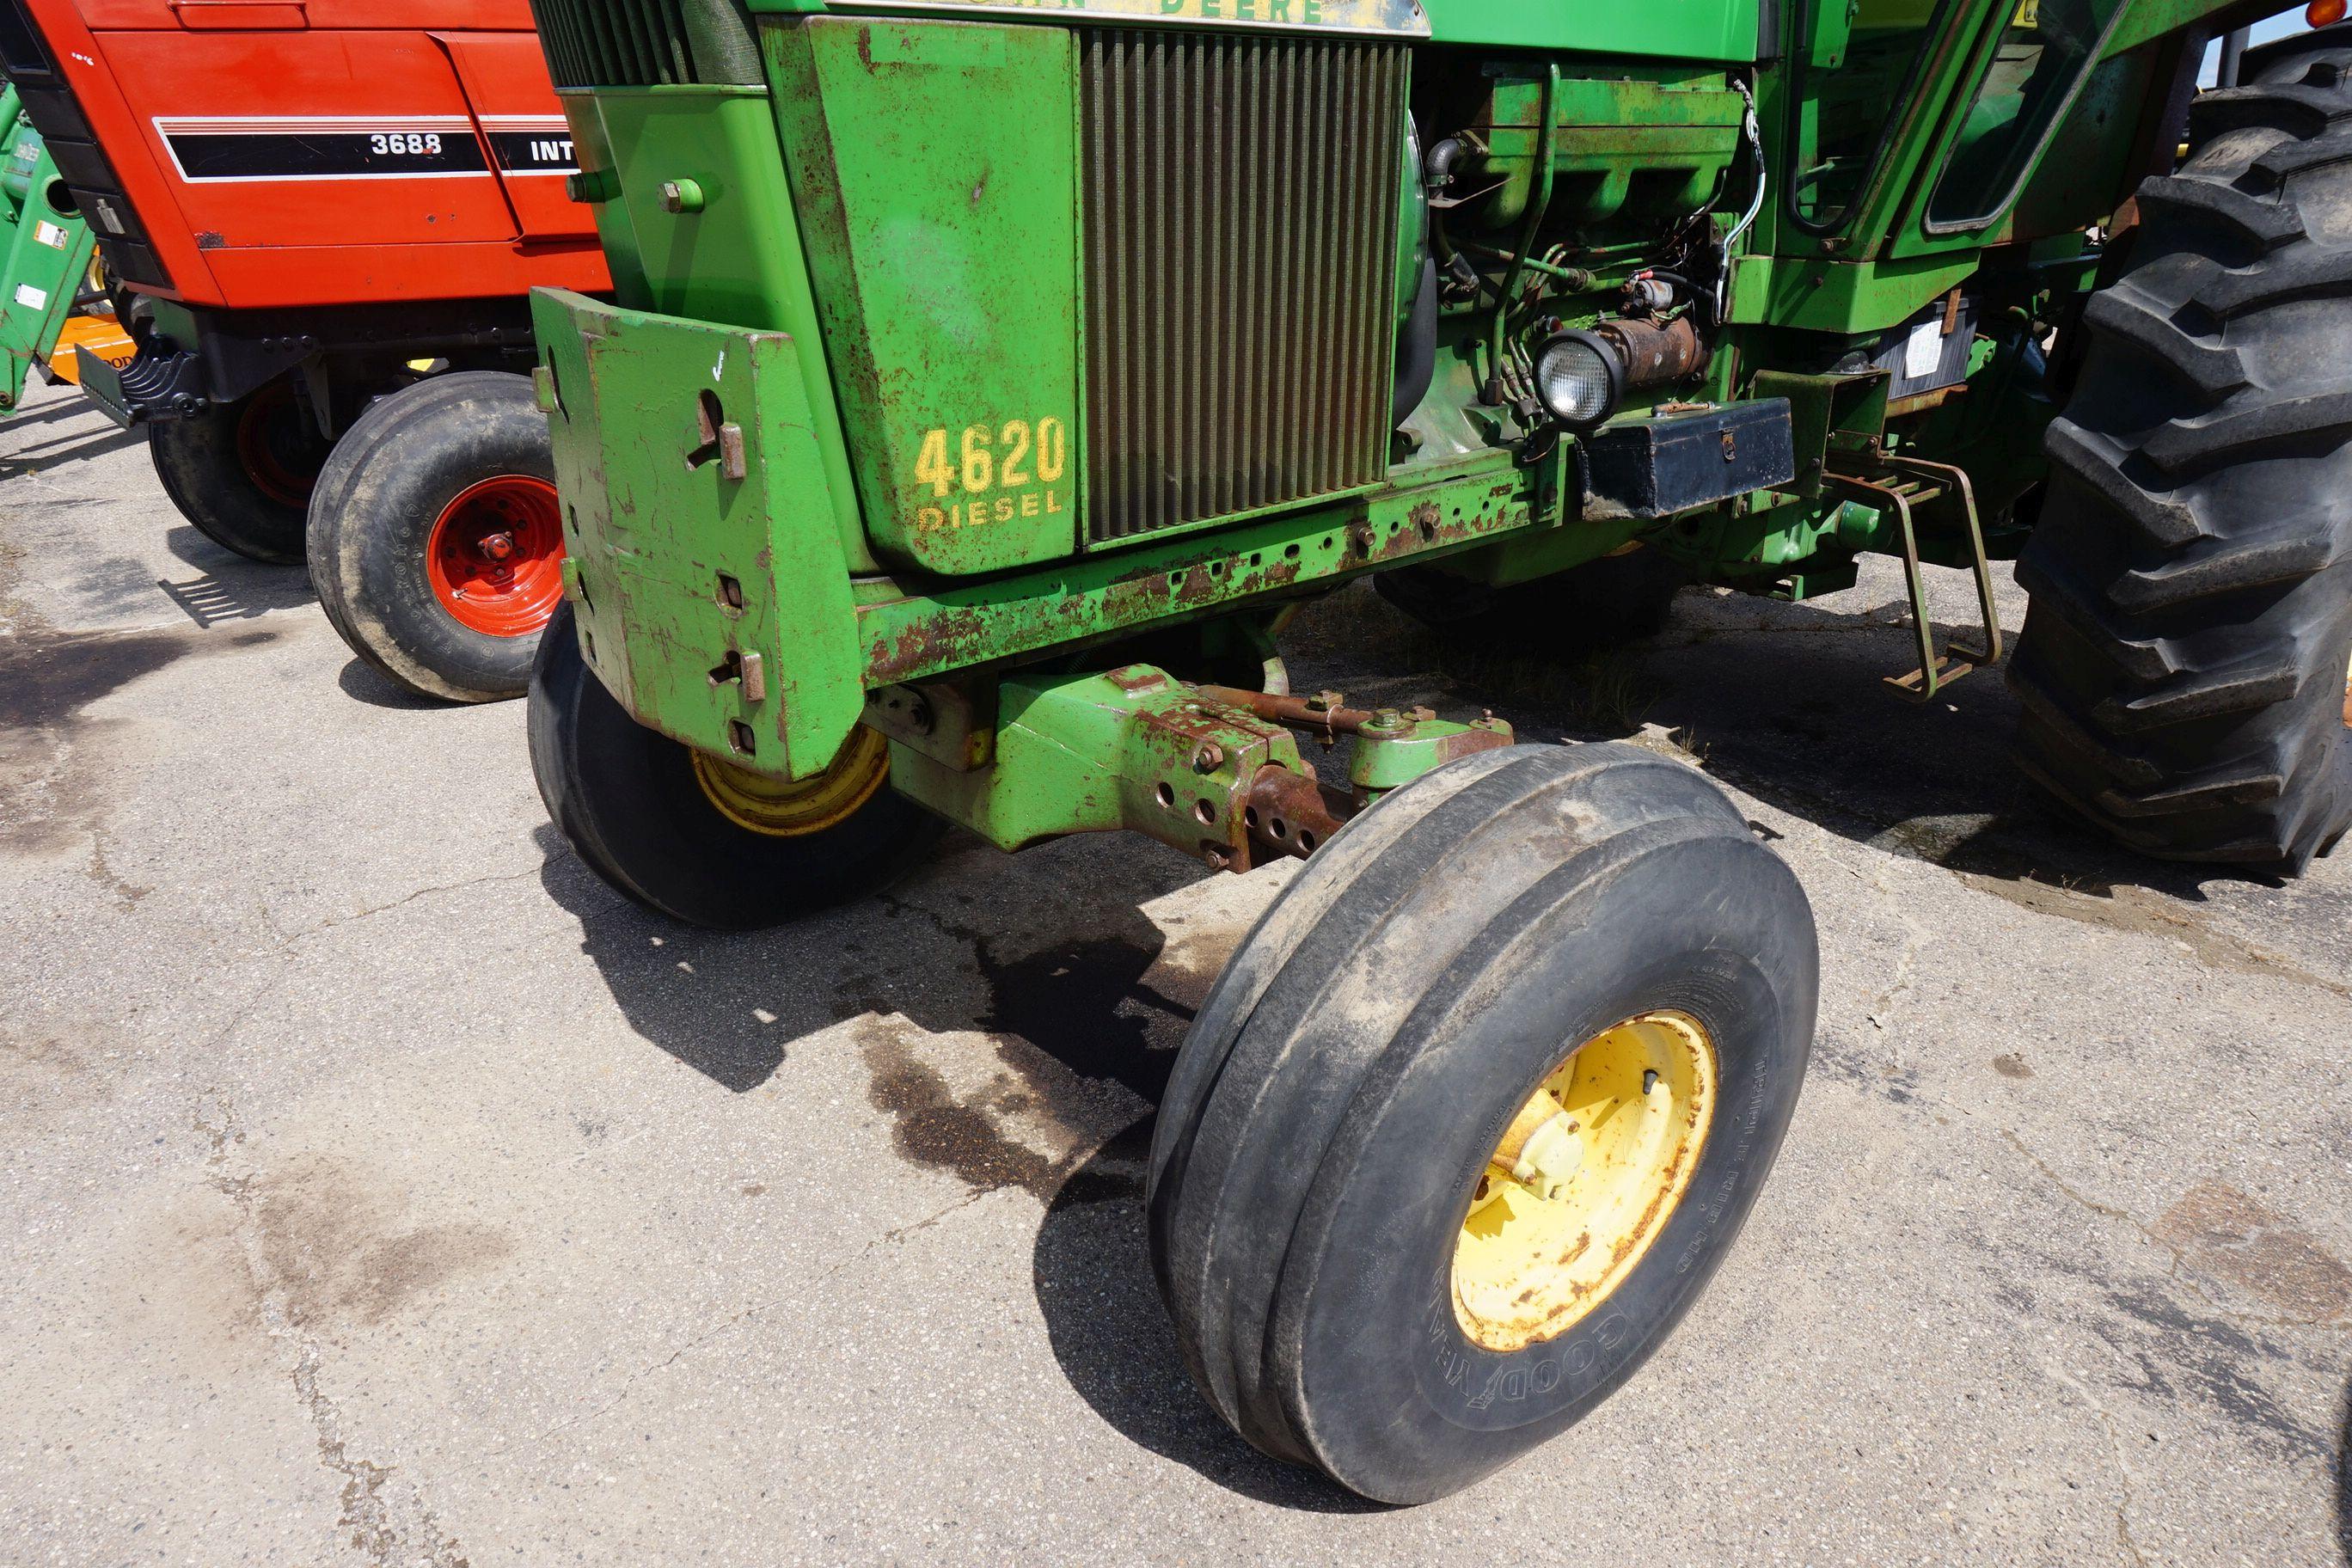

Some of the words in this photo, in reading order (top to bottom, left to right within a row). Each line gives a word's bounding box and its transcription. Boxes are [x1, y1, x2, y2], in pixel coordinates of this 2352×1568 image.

[371, 133, 442, 155] 3688
[914, 415, 1065, 498] 4620
[917, 490, 1063, 532] DIESEL
